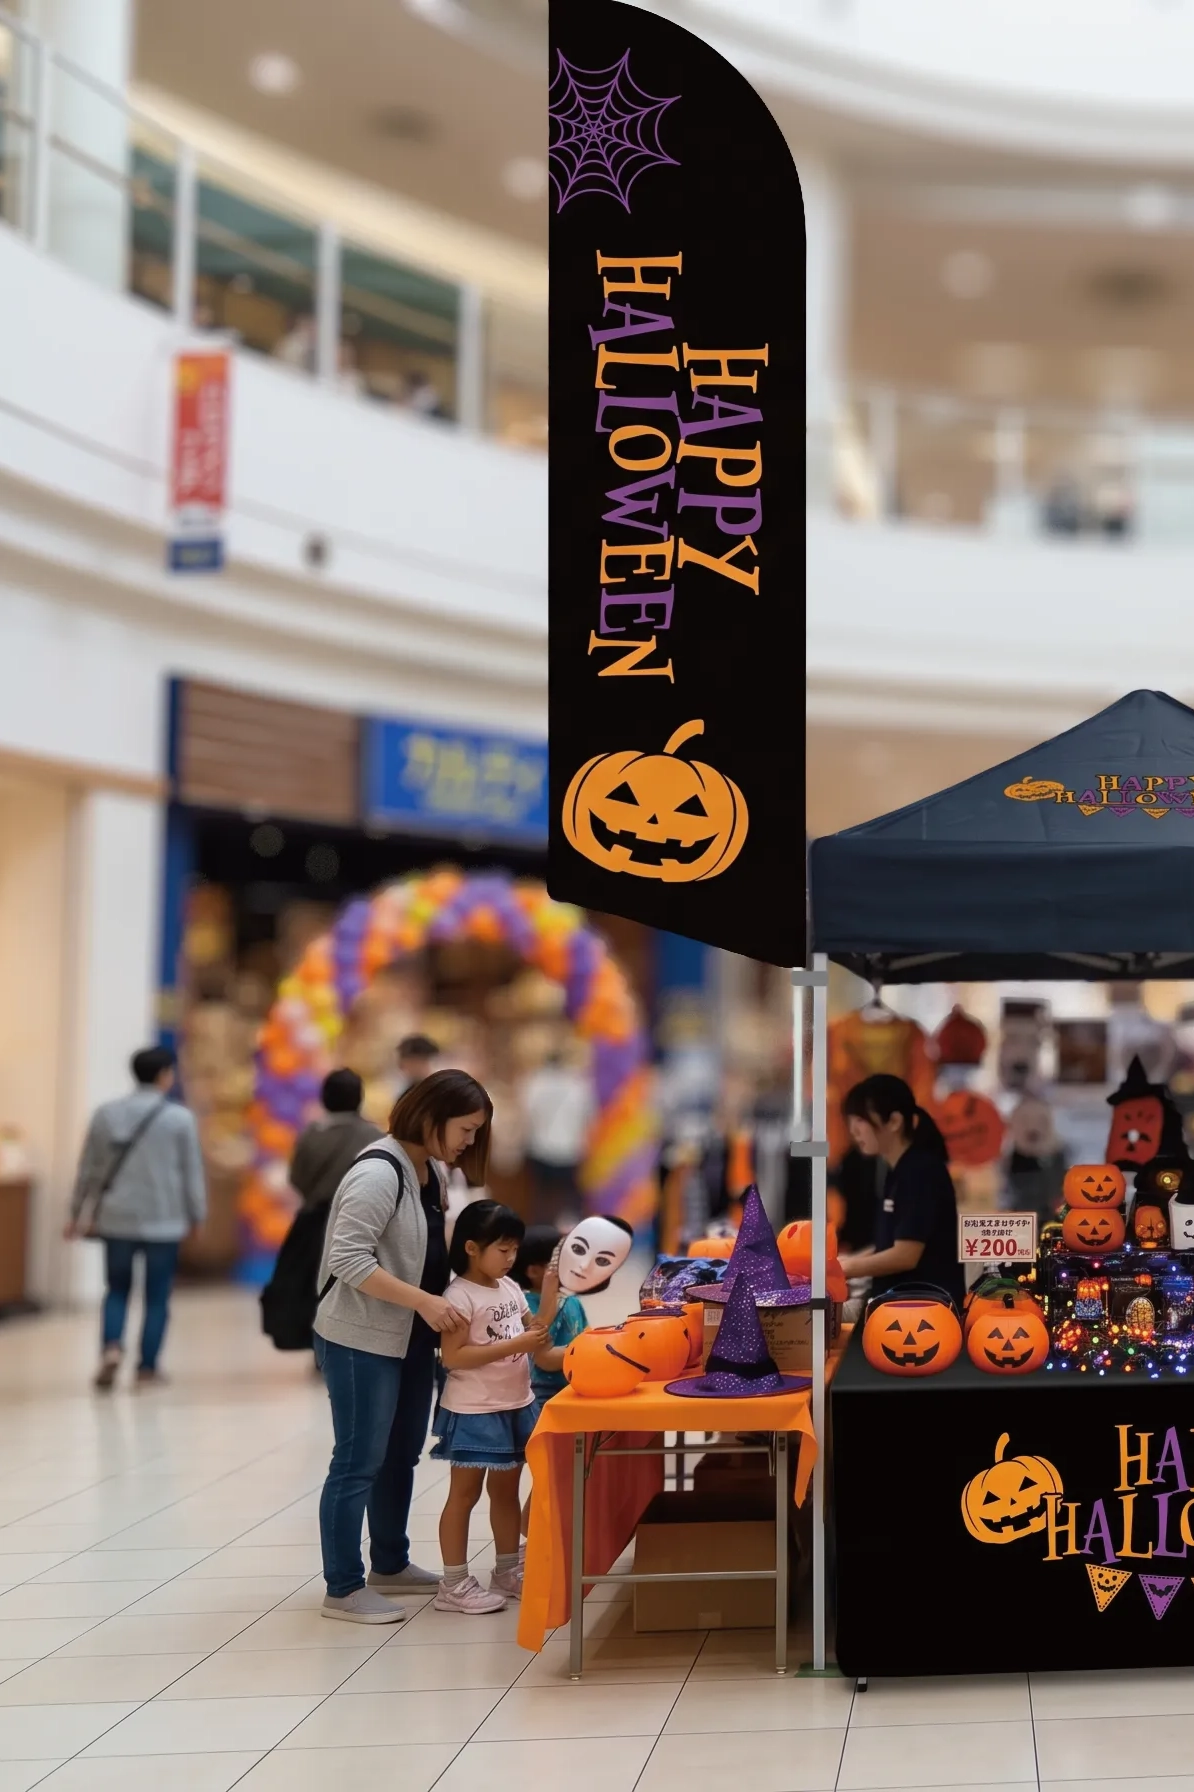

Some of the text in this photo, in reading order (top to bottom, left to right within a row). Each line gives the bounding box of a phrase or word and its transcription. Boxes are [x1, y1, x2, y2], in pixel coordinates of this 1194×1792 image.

[588, 249, 683, 684] HALLOWEEN
[676, 342, 769, 596] HAPPY
[964, 1238, 1018, 1257] ¥200
